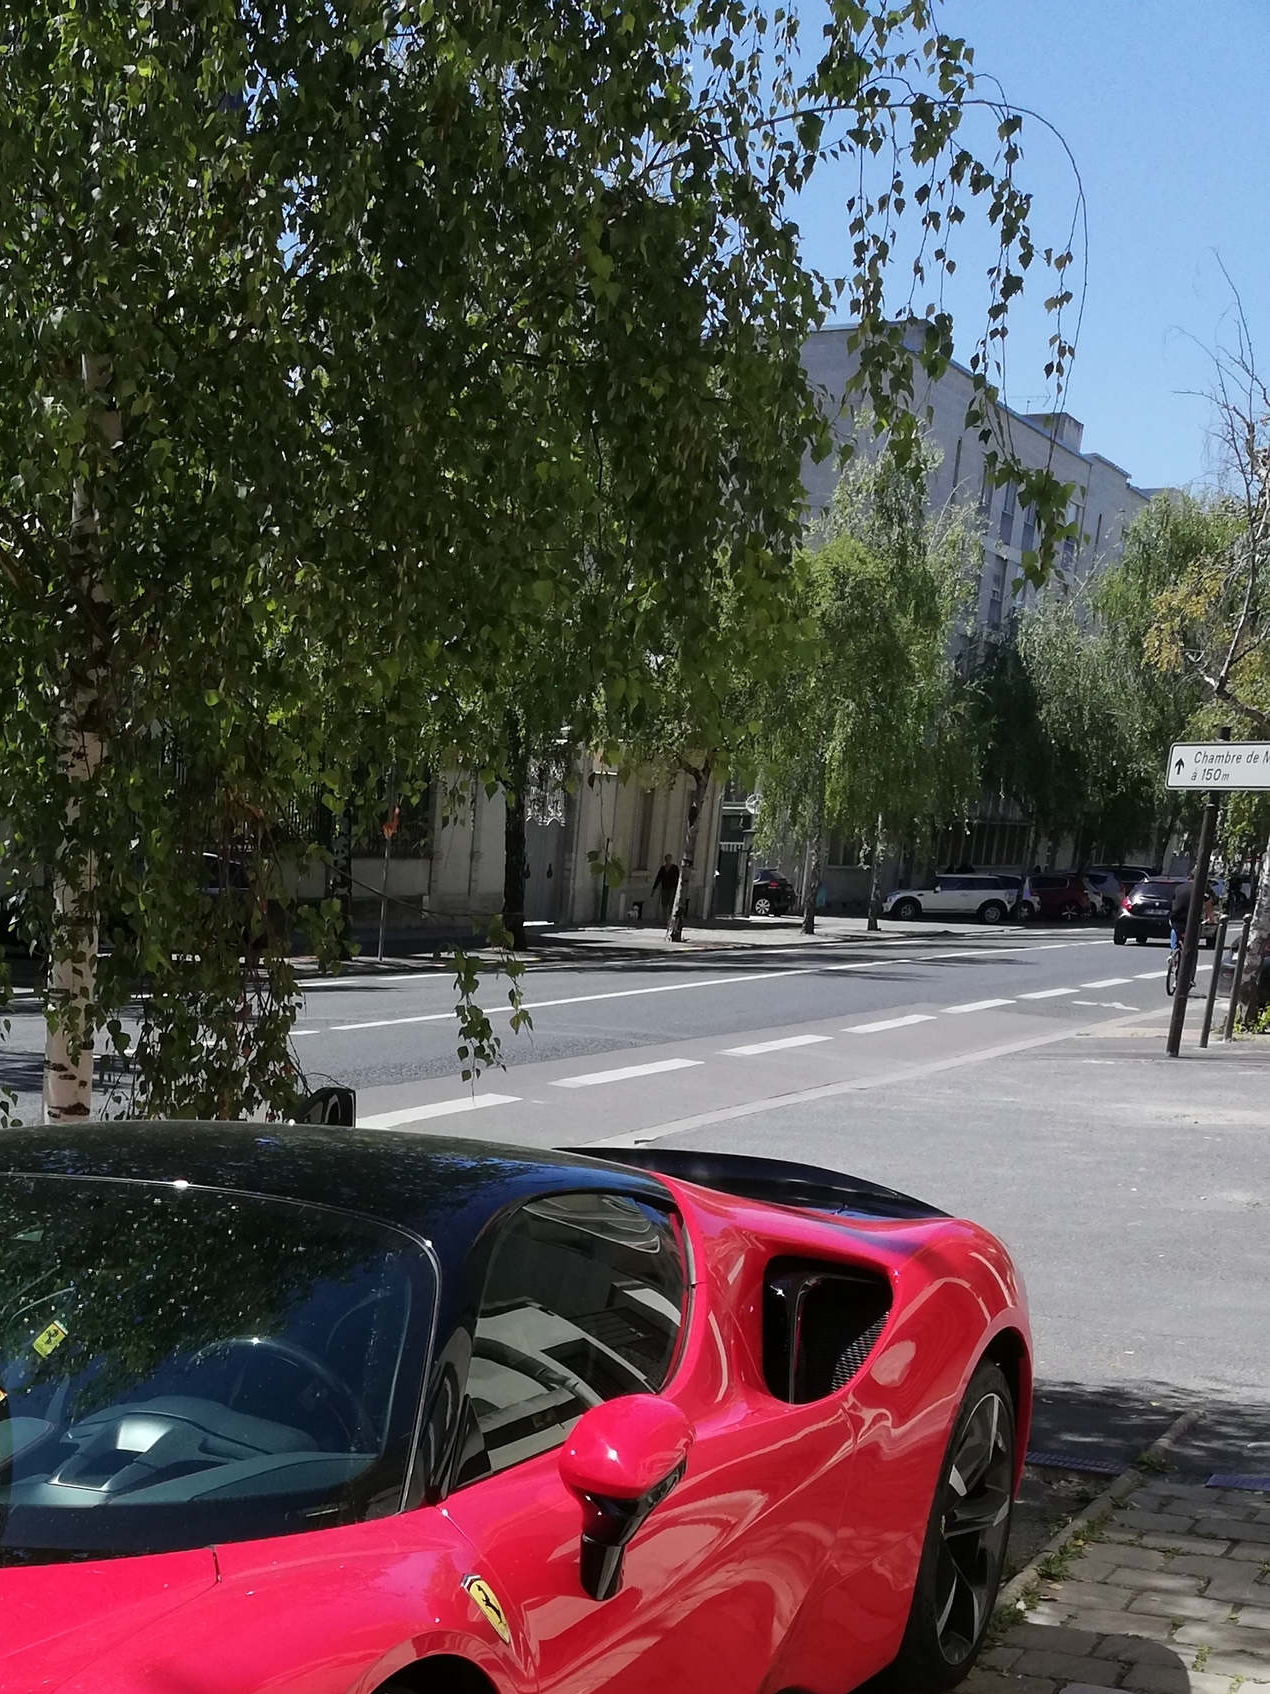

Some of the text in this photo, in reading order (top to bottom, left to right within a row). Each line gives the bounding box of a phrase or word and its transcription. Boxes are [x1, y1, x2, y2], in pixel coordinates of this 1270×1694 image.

[1194, 750, 1243, 764] Chambre
[1246, 750, 1260, 764] de
[1190, 767, 1230, 781] à 150m
